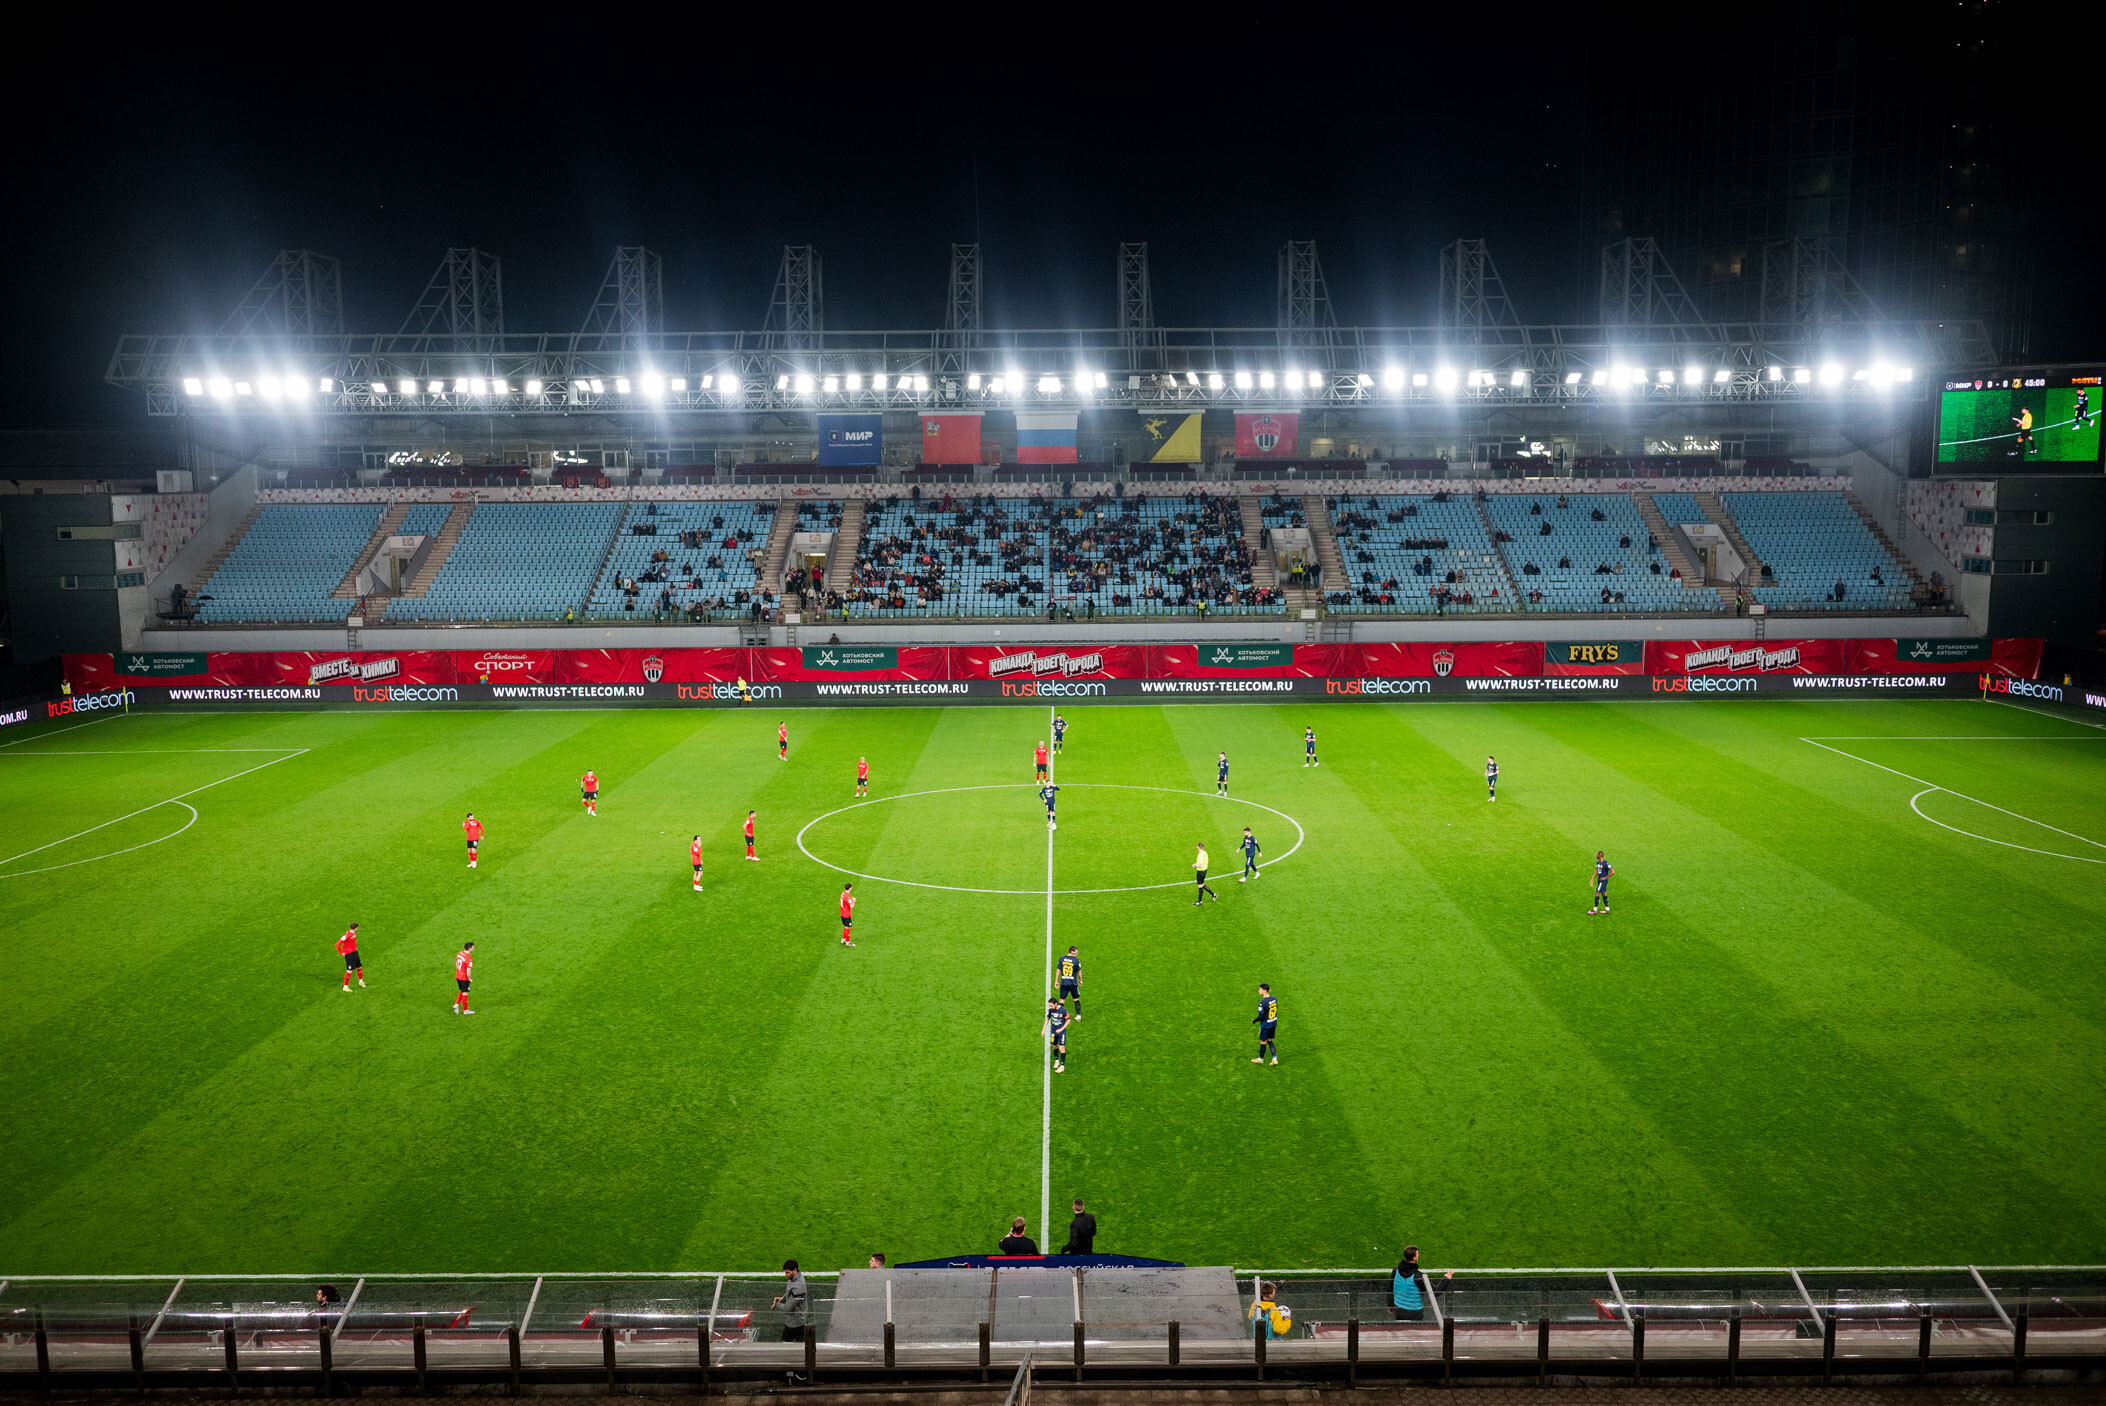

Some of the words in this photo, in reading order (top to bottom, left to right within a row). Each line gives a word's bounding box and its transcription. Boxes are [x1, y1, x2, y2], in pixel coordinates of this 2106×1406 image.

[845, 431, 874, 441] МИР
[474, 661, 535, 670] СПОРТ
[990, 652, 1034, 676] КОМАНДА
[1032, 653, 1067, 676] ТВОЕГО
[1063, 654, 1102, 676] ГОРОДА
[1686, 647, 1732, 670] КОМАНДА
[1730, 648, 1764, 669] ТВОЕГО
[1760, 649, 1799, 671] ГОРОДА
[311, 659, 350, 681] ВМЕСТЕ
[349, 665, 361, 677] ЗА
[361, 658, 398, 681] ХИМКИ
[816, 683, 969, 695] WWW.TRUST-TELECOM.RU
[1001, 680, 1106, 697] trusttelecom
[1140, 681, 1293, 692] WWW.TRUST-TELECOM.RU
[1326, 677, 1431, 694] trusttelecom
[1465, 678, 1619, 690] WWW.TRUST-TELECOM.RU
[1652, 674, 1757, 692] trusttelecom
[1792, 676, 1946, 688] WWW.TRUST-TELECOM.RU
[169, 688, 320, 700] WWW.TRUST-TELECOM.RU
[353, 684, 458, 702] trusttelecom
[493, 686, 645, 698] WWW.TRUST-TELECOM.RU
[48, 692, 135, 717] trusttelecom
